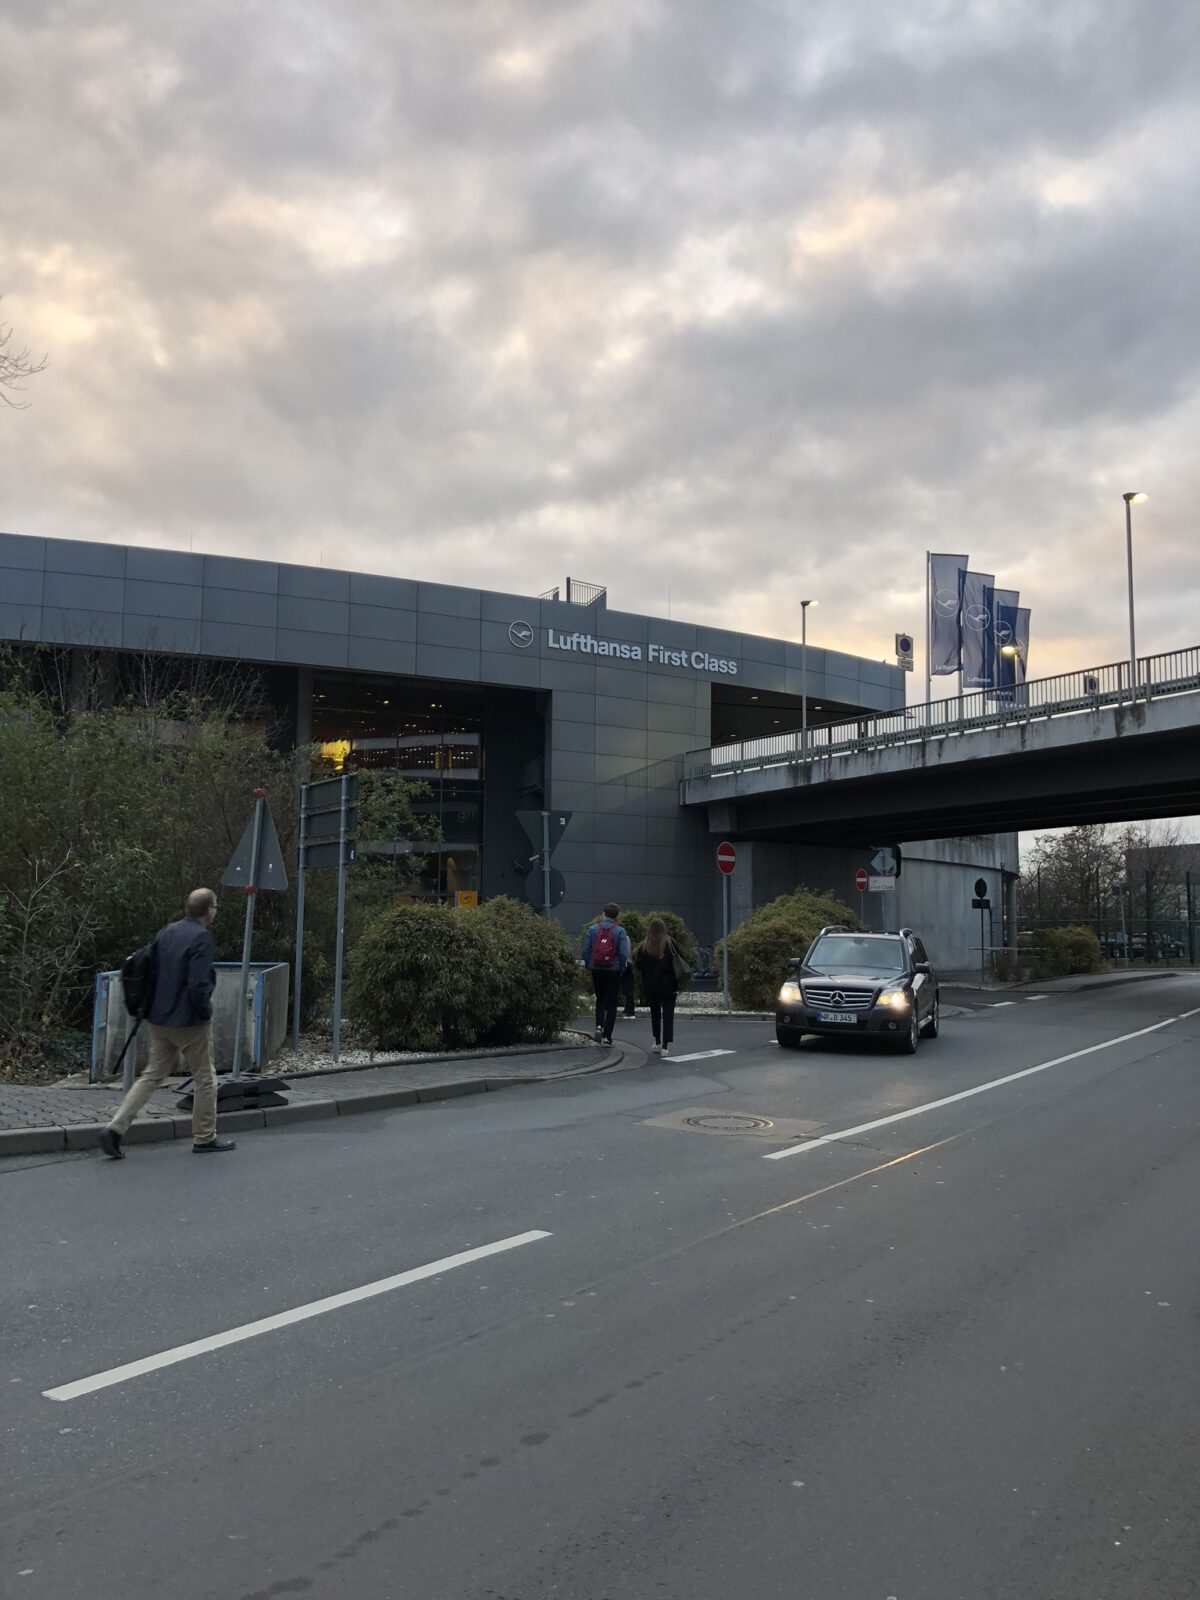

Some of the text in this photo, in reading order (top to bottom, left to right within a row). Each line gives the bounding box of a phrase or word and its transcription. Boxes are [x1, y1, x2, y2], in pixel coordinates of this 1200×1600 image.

[548, 628, 738, 675] Lufthansa First Class
